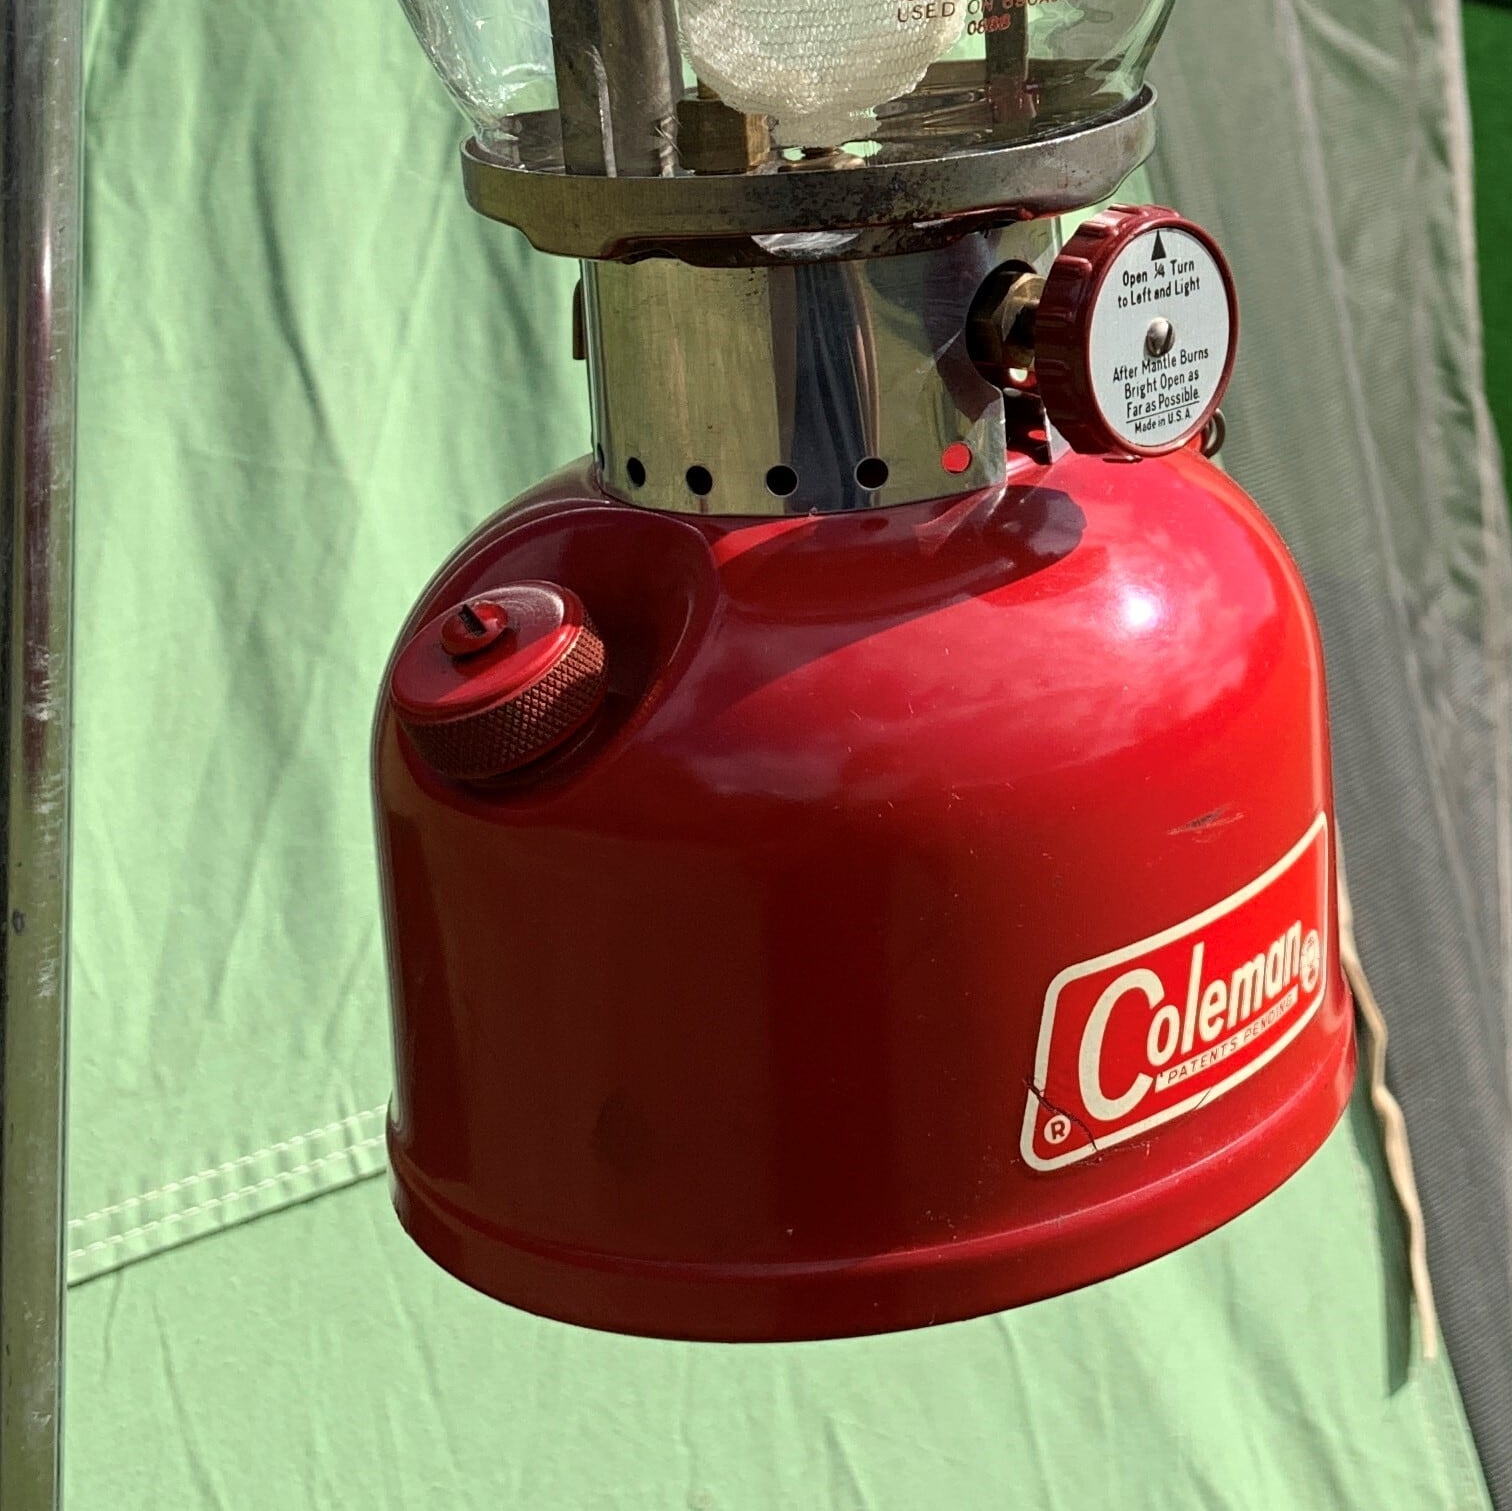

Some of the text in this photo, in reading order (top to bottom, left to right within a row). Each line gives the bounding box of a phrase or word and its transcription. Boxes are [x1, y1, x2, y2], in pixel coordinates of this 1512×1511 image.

[897, 1, 956, 23] USED
[1122, 270, 1148, 288] Open
[1170, 259, 1195, 276] Turn
[1117, 276, 1200, 308] to Left and Light
[1113, 348, 1209, 383] After Mantle Burns
[1124, 369, 1199, 400] Bright Open as
[1126, 401, 1142, 419] Far
[1145, 400, 1157, 413] as
[1134, 418, 1156, 434] Made
[1158, 415, 1166, 427] in
[1078, 919, 1303, 1121] Coleman
[1167, 1036, 1238, 1084] PATENTS
